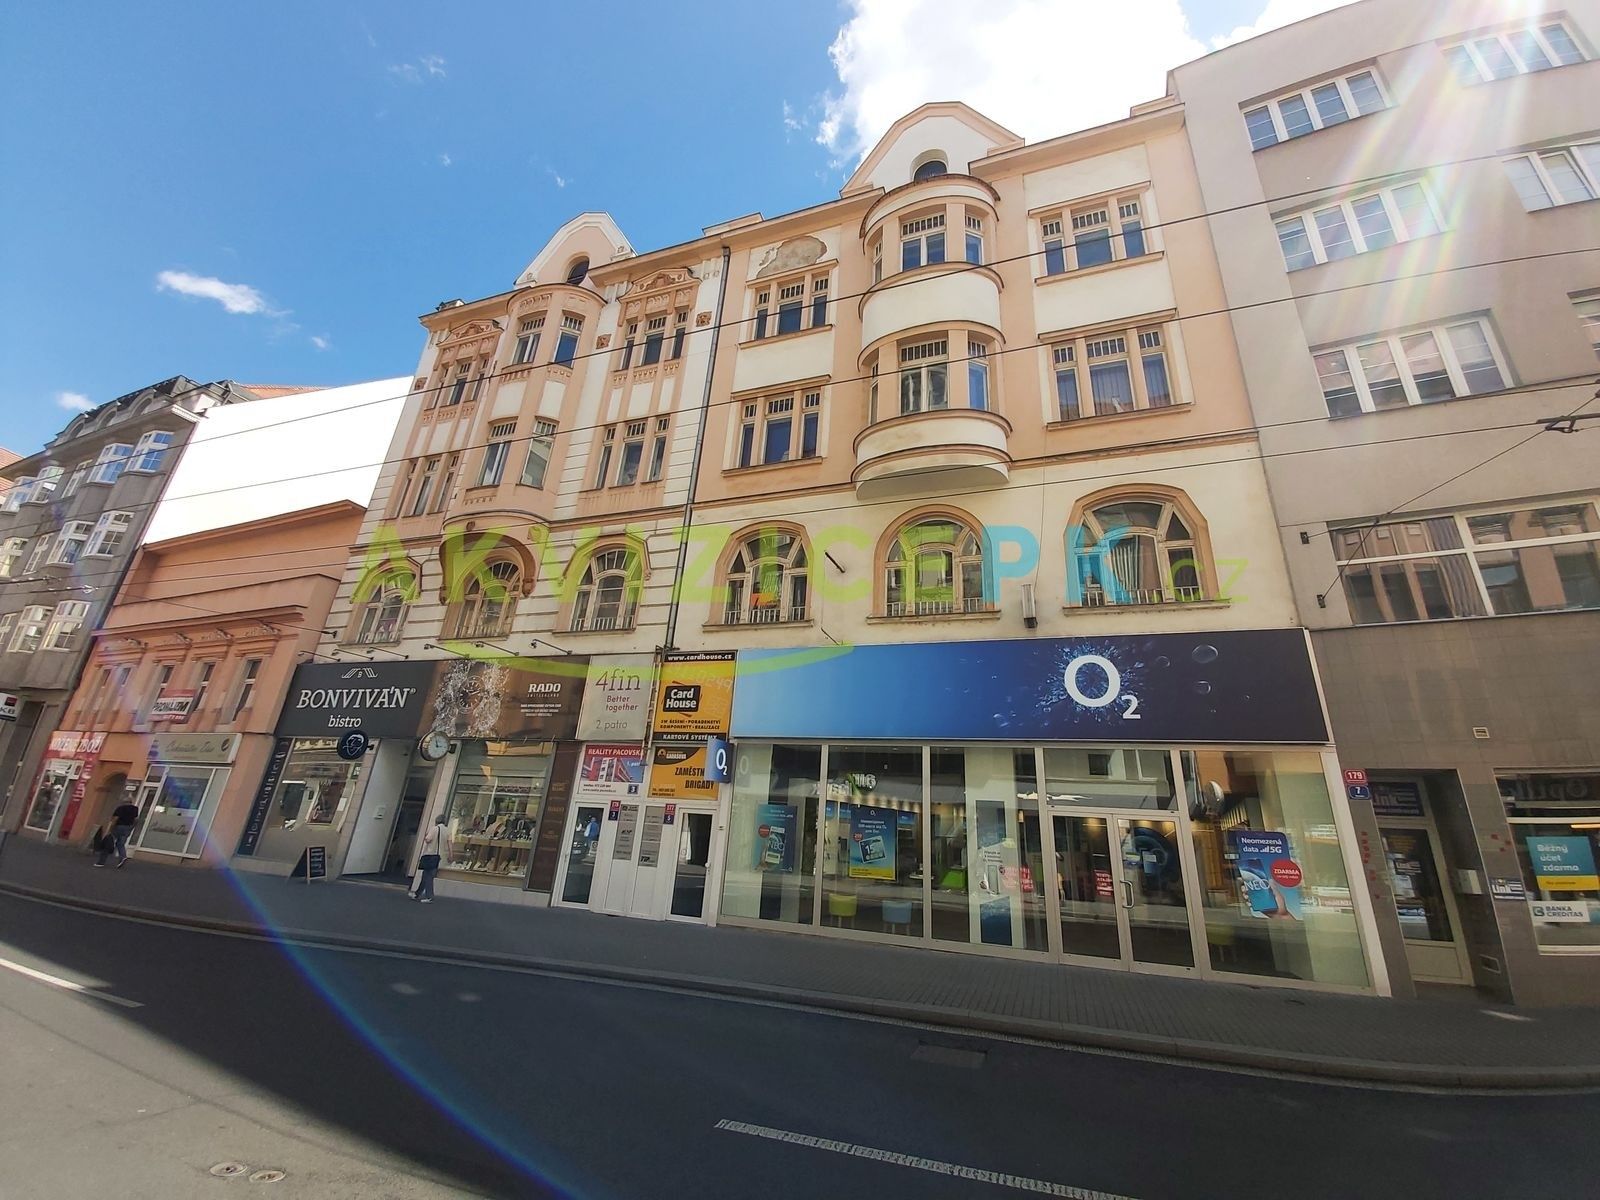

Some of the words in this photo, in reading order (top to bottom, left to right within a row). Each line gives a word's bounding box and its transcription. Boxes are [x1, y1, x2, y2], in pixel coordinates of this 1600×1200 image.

[668, 652, 732, 661] www.cardhouse.cz
[596, 668, 641, 691] 4fin
[528, 683, 561, 692] RADO
[1064, 655, 1141, 719] O2
[671, 688, 694, 699] Card
[607, 695, 630, 703] Better
[606, 703, 639, 713] together
[665, 699, 697, 709] House
[328, 715, 362, 727] bistro
[604, 720, 628, 731] patro
[715, 748, 728, 775] O2
[1348, 771, 1363, 780] 179
[1355, 786, 1361, 795] 7
[1241, 837, 1282, 845] Neomezená
[1243, 845, 1259, 853] data
[1270, 846, 1282, 854] 5G
[1536, 844, 1569, 854] Běžný
[1540, 854, 1561, 862] účet
[1273, 868, 1300, 876] ZDARMA
[1543, 864, 1580, 872] zdarma
